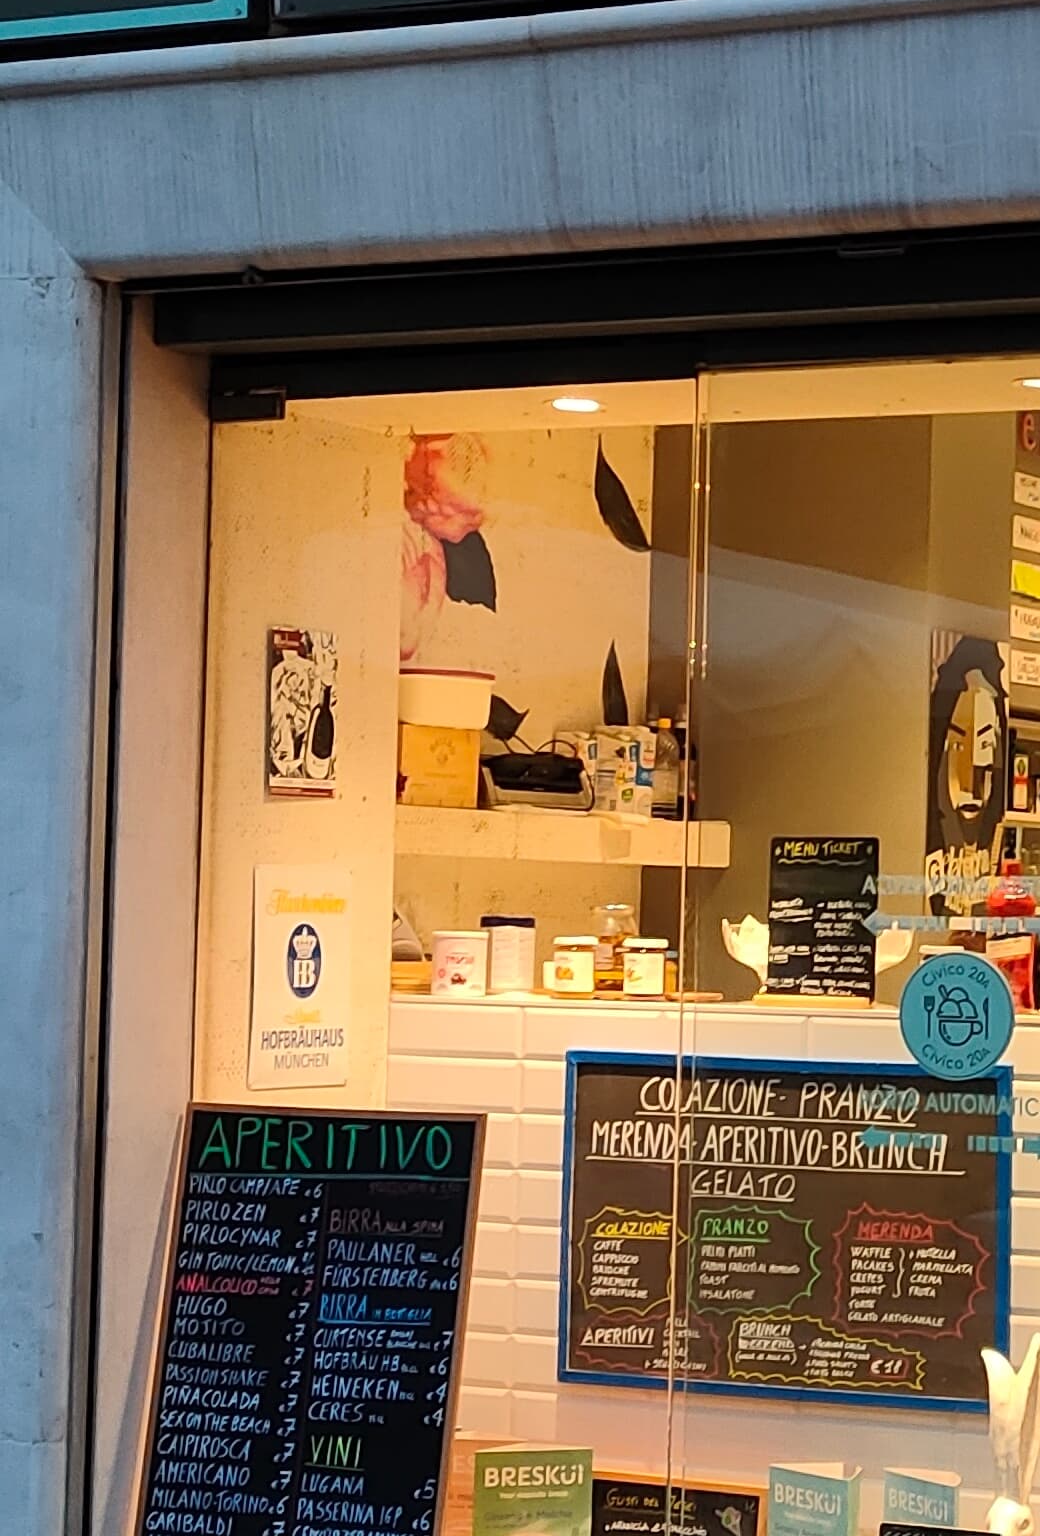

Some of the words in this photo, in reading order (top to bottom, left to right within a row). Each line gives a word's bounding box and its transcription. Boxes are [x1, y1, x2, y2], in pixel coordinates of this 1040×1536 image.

[921, 964, 965, 987] Civico
[261, 1026, 344, 1051] HOFBRÄUHAUS
[274, 1052, 329, 1070] MÜNCHEN
[921, 1044, 965, 1070] Civico
[800, 1082, 920, 1124] PRANZO
[199, 1117, 452, 1170] APERITIVO
[690, 1169, 796, 1199] GELATO
[594, 1221, 672, 1237] COLAZIONE
[702, 1218, 769, 1237] PRANZO
[856, 1218, 934, 1240] MERENDA
[327, 1239, 416, 1264] PAULANER
[176, 1296, 227, 1316] HUGO
[319, 1294, 368, 1320] BIRRA
[581, 1325, 655, 1345] APERITIVI
[311, 1374, 399, 1400] HEINEKEN
[308, 1401, 365, 1422] CERES
[157, 1433, 251, 1461] CAIPIROSCA
[311, 1434, 361, 1468] VINI
[154, 1459, 250, 1487] AMERICANO
[300, 1473, 364, 1496] LUGANA
[145, 1511, 233, 1536] GARIBALDI
[296, 1498, 374, 1525] PASSERINA
